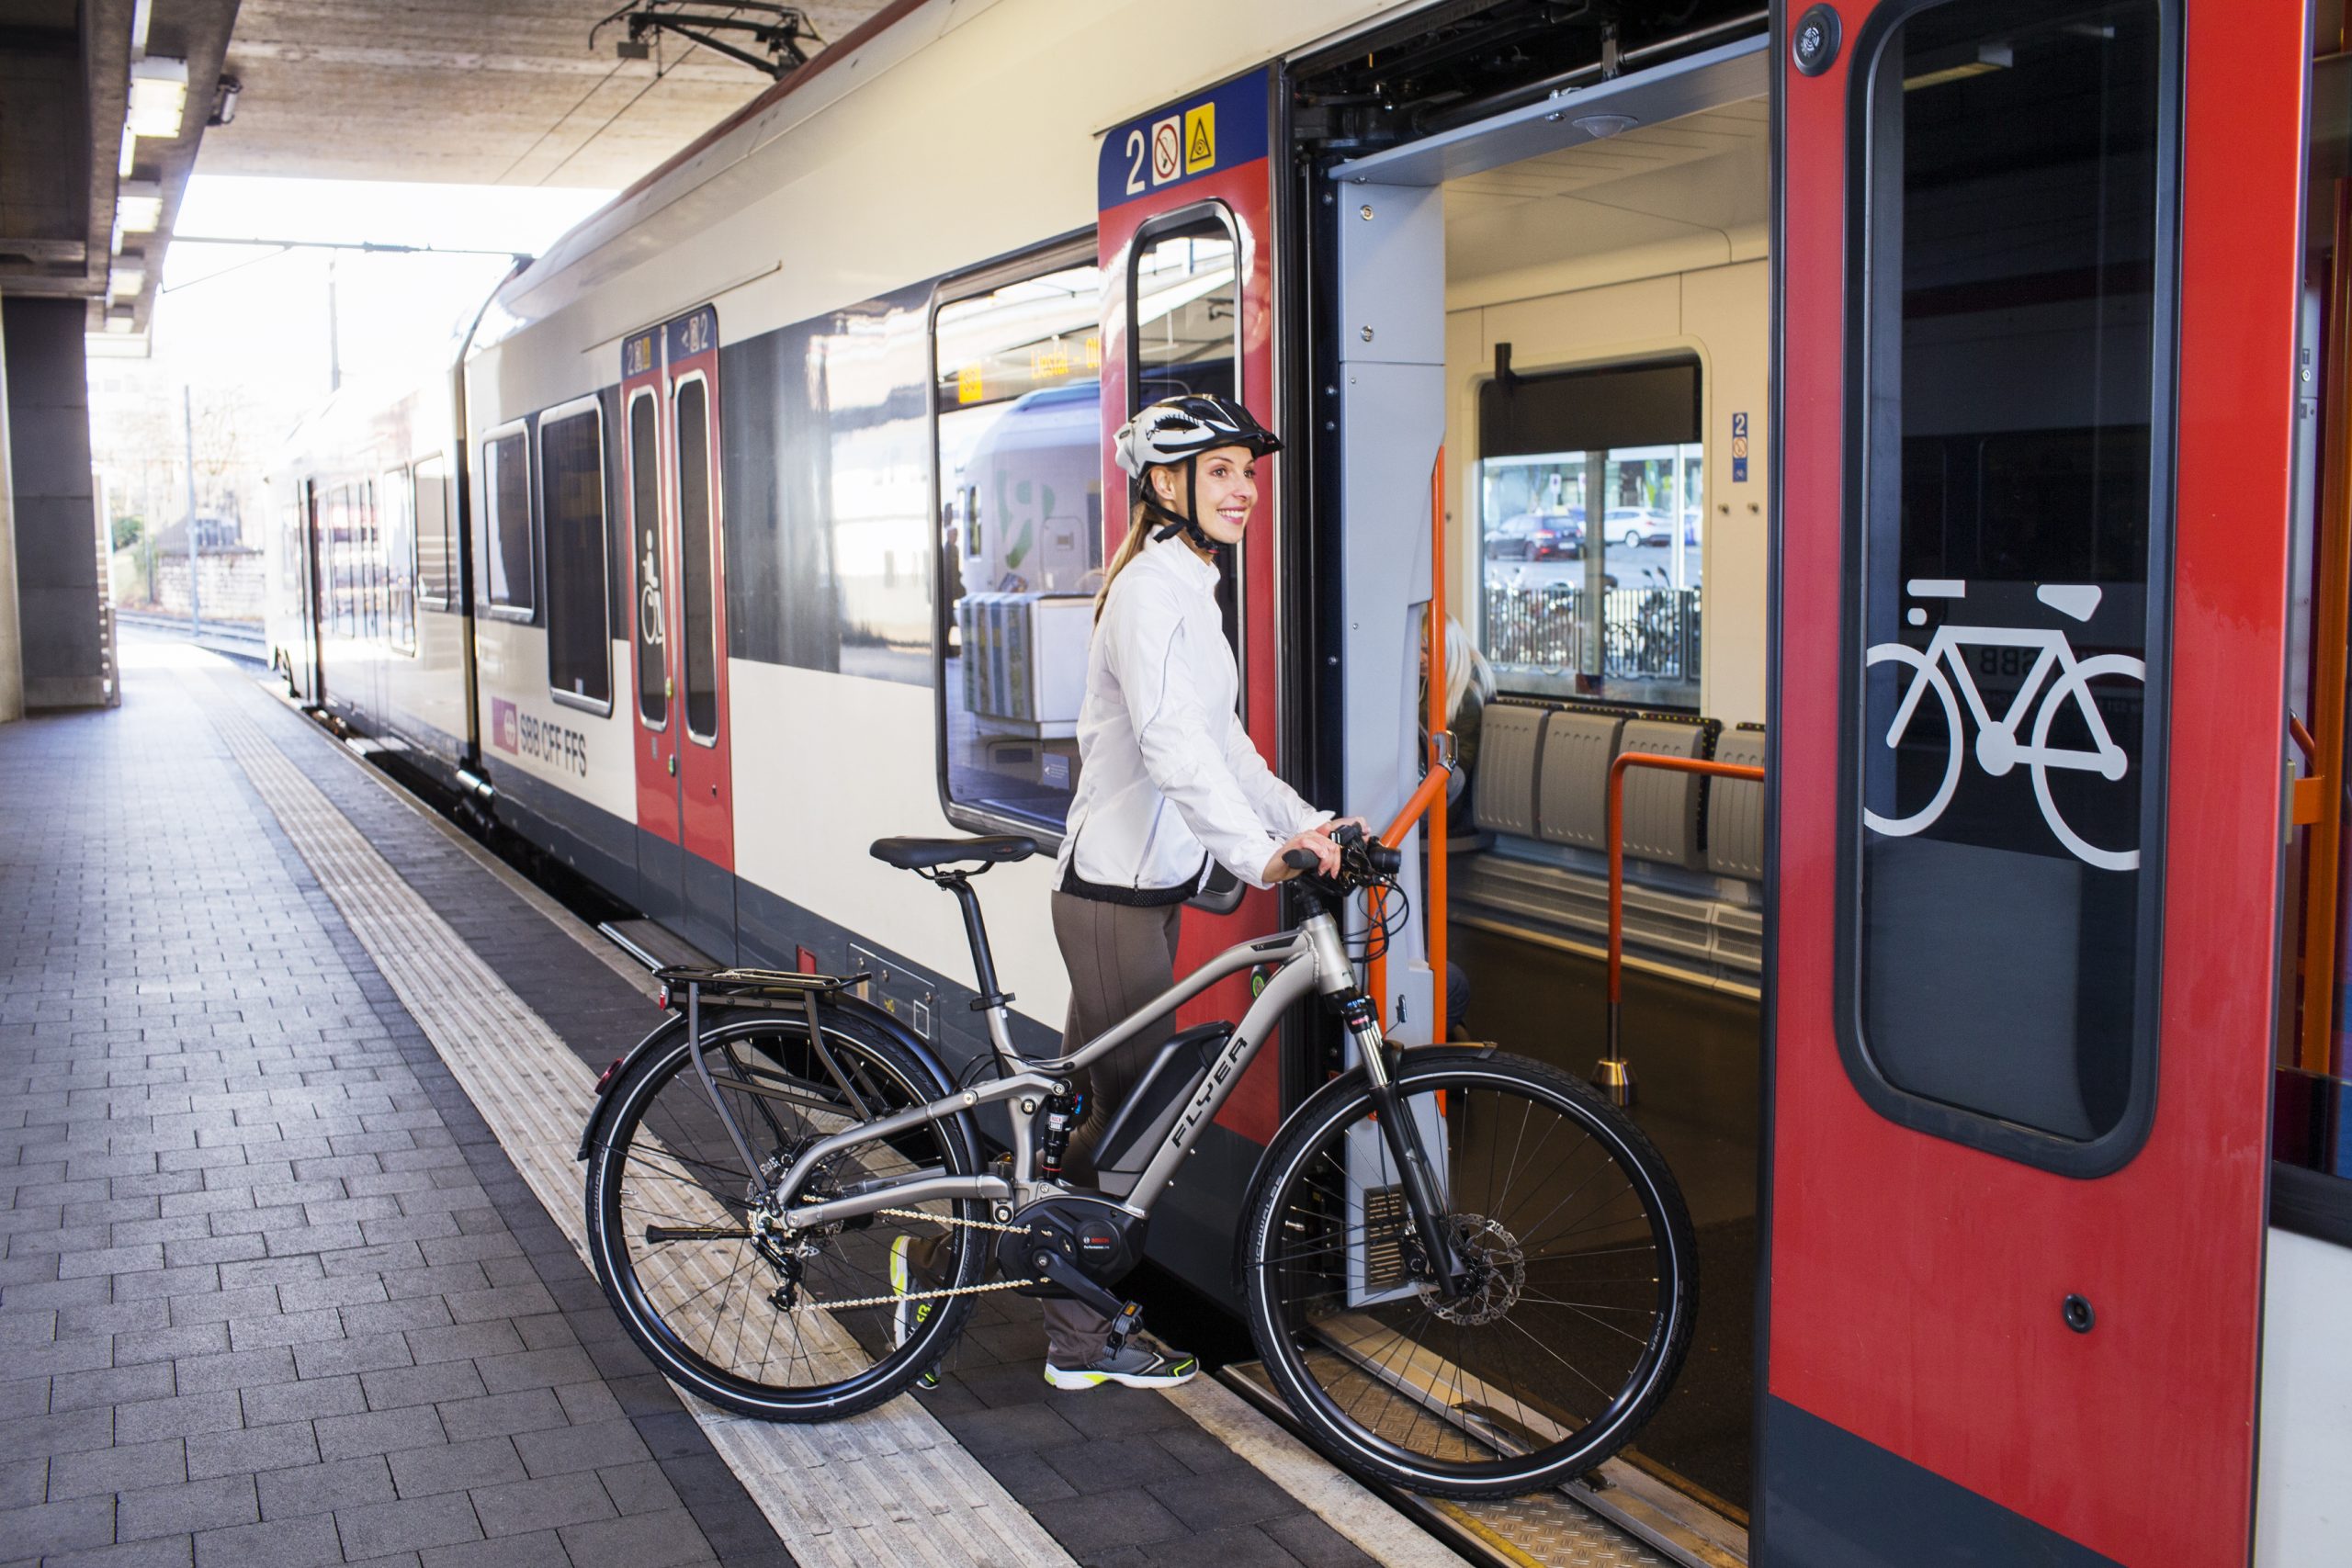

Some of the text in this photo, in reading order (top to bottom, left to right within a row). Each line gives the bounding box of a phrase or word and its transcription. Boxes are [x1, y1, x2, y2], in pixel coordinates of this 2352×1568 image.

[1125, 130, 1146, 196] 2
[627, 343, 634, 376] 2
[700, 312, 708, 349] 2
[1735, 413, 1746, 435] 2
[519, 713, 587, 778] SBB CFF FFS
[1171, 1037, 1248, 1148] FLYER
[1256, 1175, 1283, 1270] SCHWALBE
